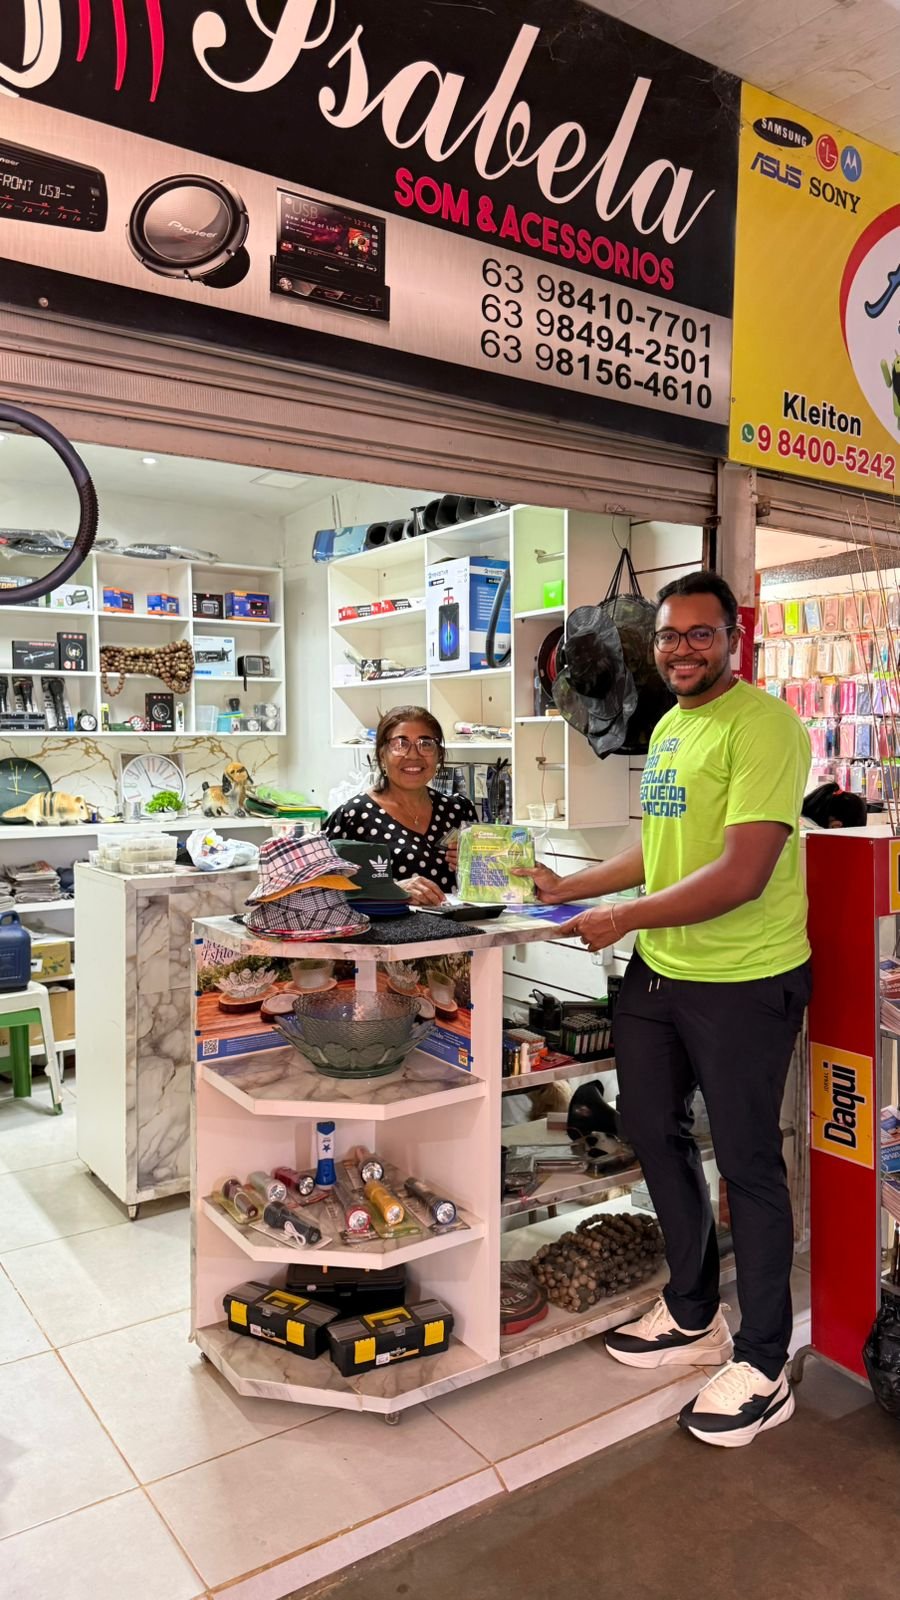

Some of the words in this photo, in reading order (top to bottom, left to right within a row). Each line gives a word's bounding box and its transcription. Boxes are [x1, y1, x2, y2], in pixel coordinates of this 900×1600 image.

[761, 117, 808, 147] SAMSUNG
[750, 151, 803, 190] ASUS
[808, 176, 862, 214] SONY
[168, 220, 218, 238] Pioneer
[394, 167, 470, 226] SOM
[476, 195, 498, 234] &
[500, 203, 675, 290] ACESSORIOS
[482, 257, 524, 293] 63
[536, 273, 712, 349] 98410-7701
[481, 293, 524, 328] 63
[535, 308, 711, 379] 98494-2501
[480, 329, 523, 364] 63
[535, 342, 713, 409] 98156-4610
[782, 390, 862, 436] Kleiton
[757, 424, 772, 452] 9
[777, 429, 896, 481] 8400-5242
[823, 1064, 866, 1149] Daqui
